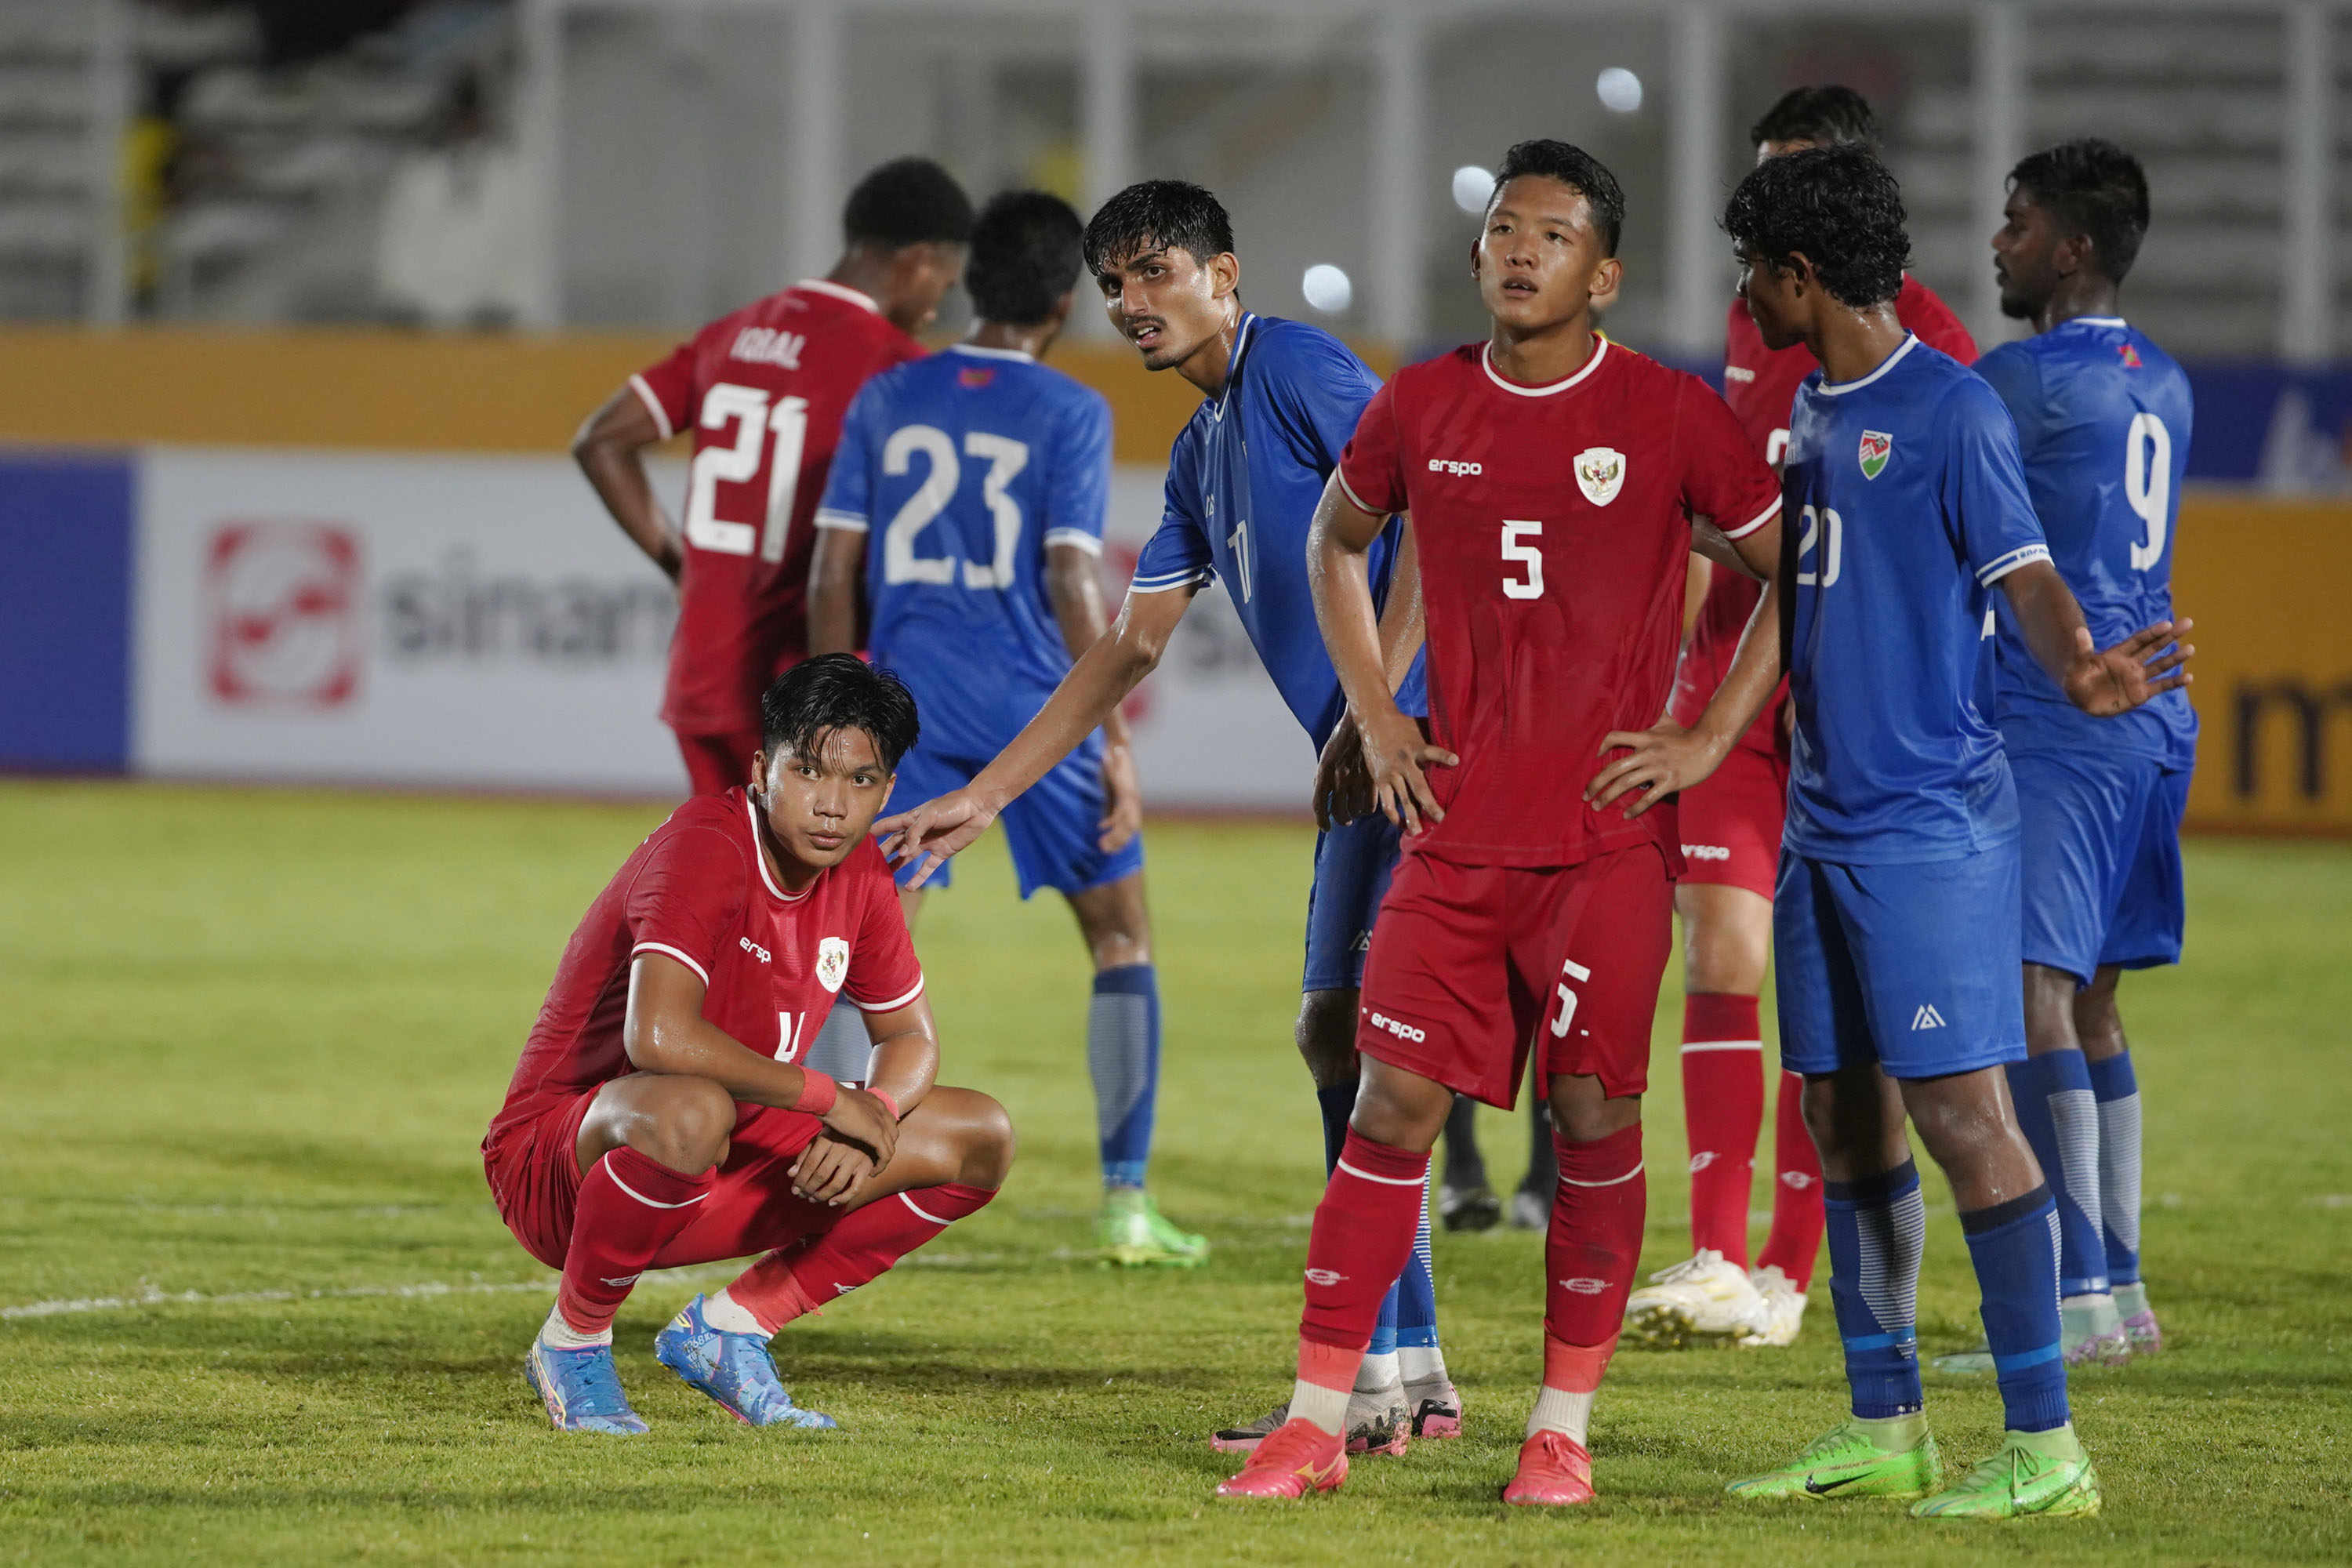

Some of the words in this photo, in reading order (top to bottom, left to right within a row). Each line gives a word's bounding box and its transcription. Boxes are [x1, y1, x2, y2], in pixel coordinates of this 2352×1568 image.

[684, 382, 808, 563] 21
[883, 424, 1029, 590] 23
[1428, 459, 1483, 477] erspo
[2125, 412, 2172, 570] 9
[1501, 519, 1544, 600] 5
[1796, 503, 1843, 588] 20
[739, 936, 772, 964] ersp
[1371, 1012, 1426, 1044] erspo
[1551, 958, 1591, 1039] 5
